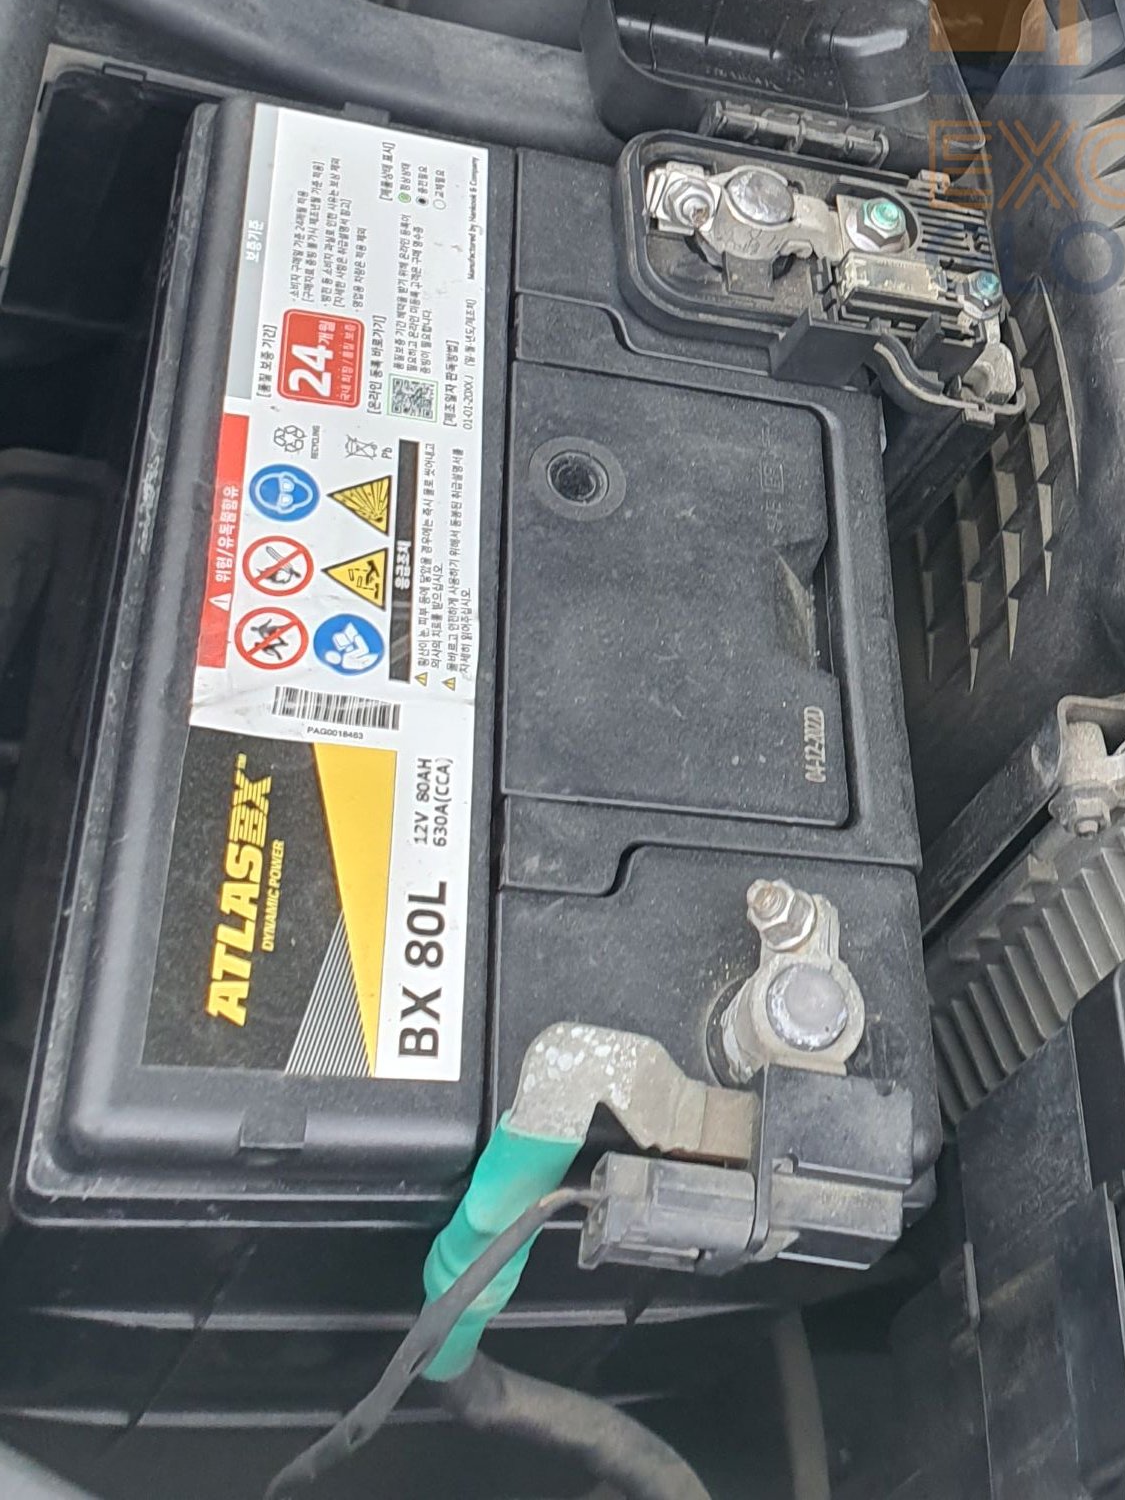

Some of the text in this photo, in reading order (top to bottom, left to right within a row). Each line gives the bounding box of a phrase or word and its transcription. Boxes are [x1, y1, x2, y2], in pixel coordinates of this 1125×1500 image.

[469, 156, 479, 186] Company
[468, 194, 478, 222] Hankook
[245, 219, 264, 262] 보증기준
[467, 234, 477, 280] Manufactured
[261, 324, 278, 348] 기간]
[260, 351, 274, 371] 보증
[366, 314, 387, 414] [온라인 등록 바로가기]
[442, 384, 458, 426] [제조일자
[310, 425, 320, 460] RECYCLING
[380, 447, 392, 459] Pb
[214, 484, 240, 582] 위험/유독물함유
[394, 540, 412, 590] 응급조치
[414, 757, 432, 845] 12V 80AH
[433, 756, 453, 847] 630A(CCA)
[261, 839, 285, 952] DYNAMIC POWER
[398, 880, 448, 1059] BX 80L
